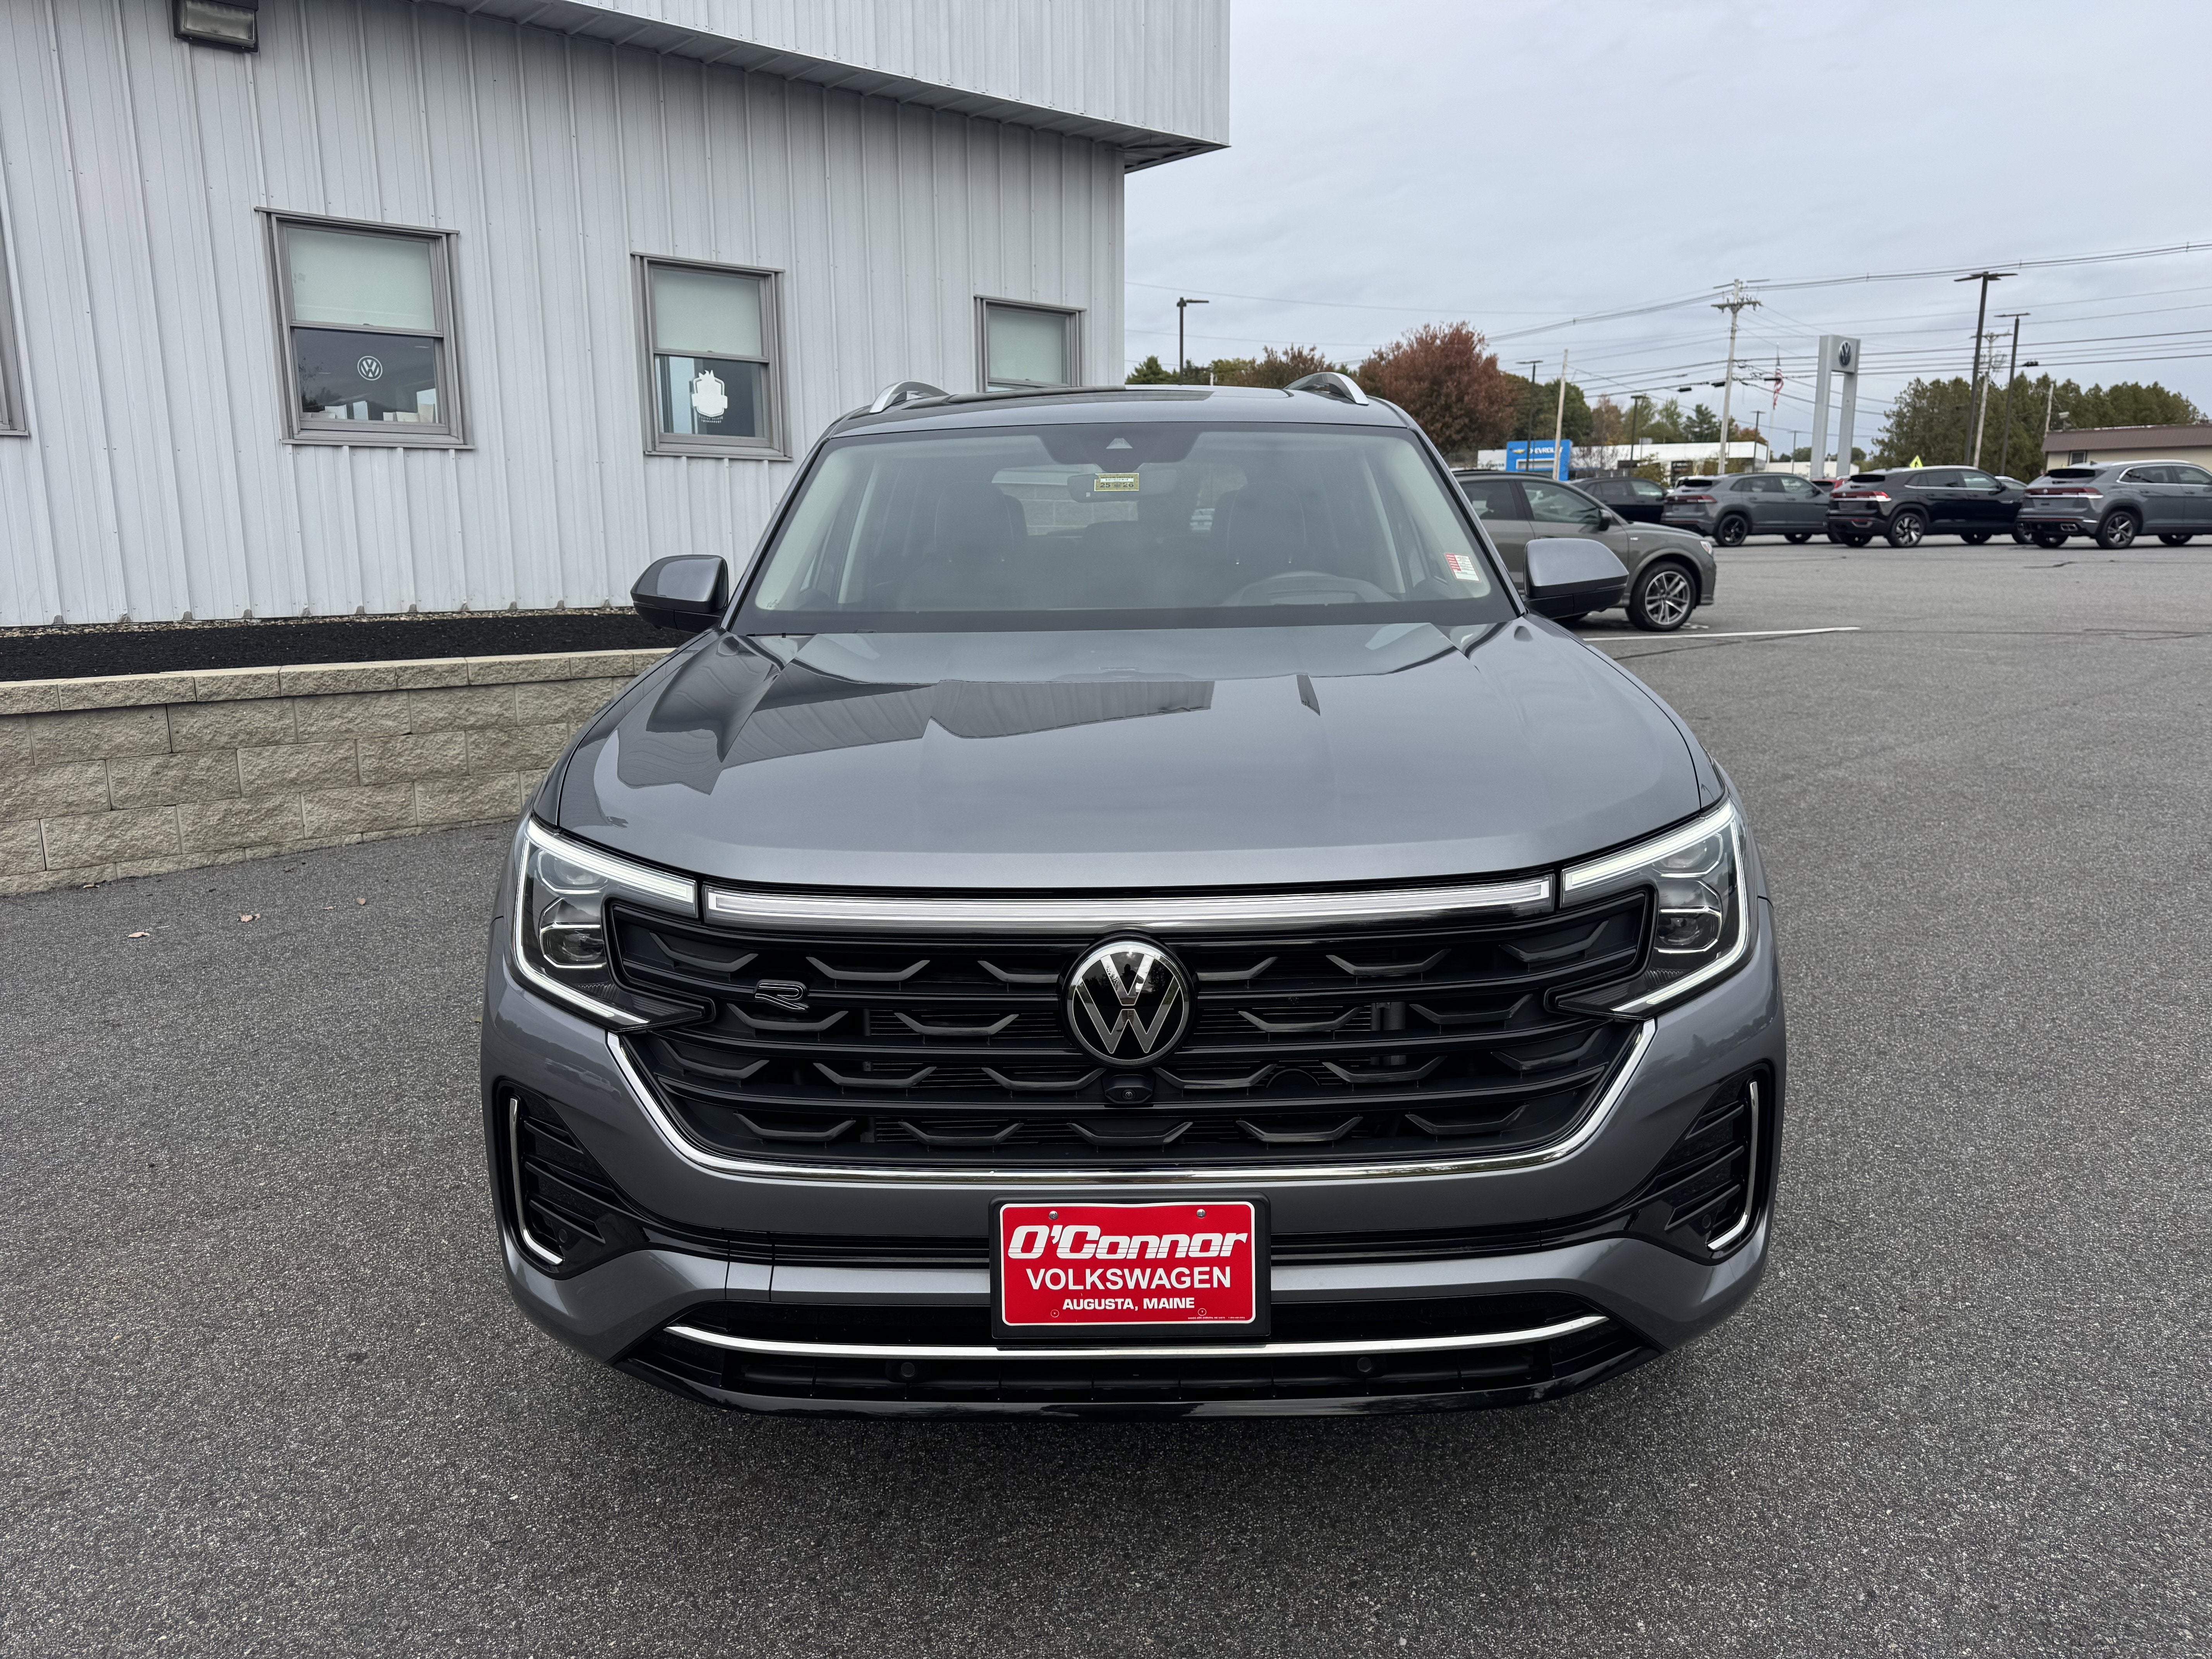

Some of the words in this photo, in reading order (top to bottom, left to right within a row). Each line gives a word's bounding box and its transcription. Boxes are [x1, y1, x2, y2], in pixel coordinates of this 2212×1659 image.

[358, 357, 381, 379] VW
[1073, 950, 1183, 1057] VW
[1008, 1225, 1248, 1259] O'Connor
[1026, 1266, 1230, 1290] VOLKSWAGEN
[1063, 1298, 1139, 1311] AUGUSTA,
[1144, 1297, 1195, 1309] MAINE
